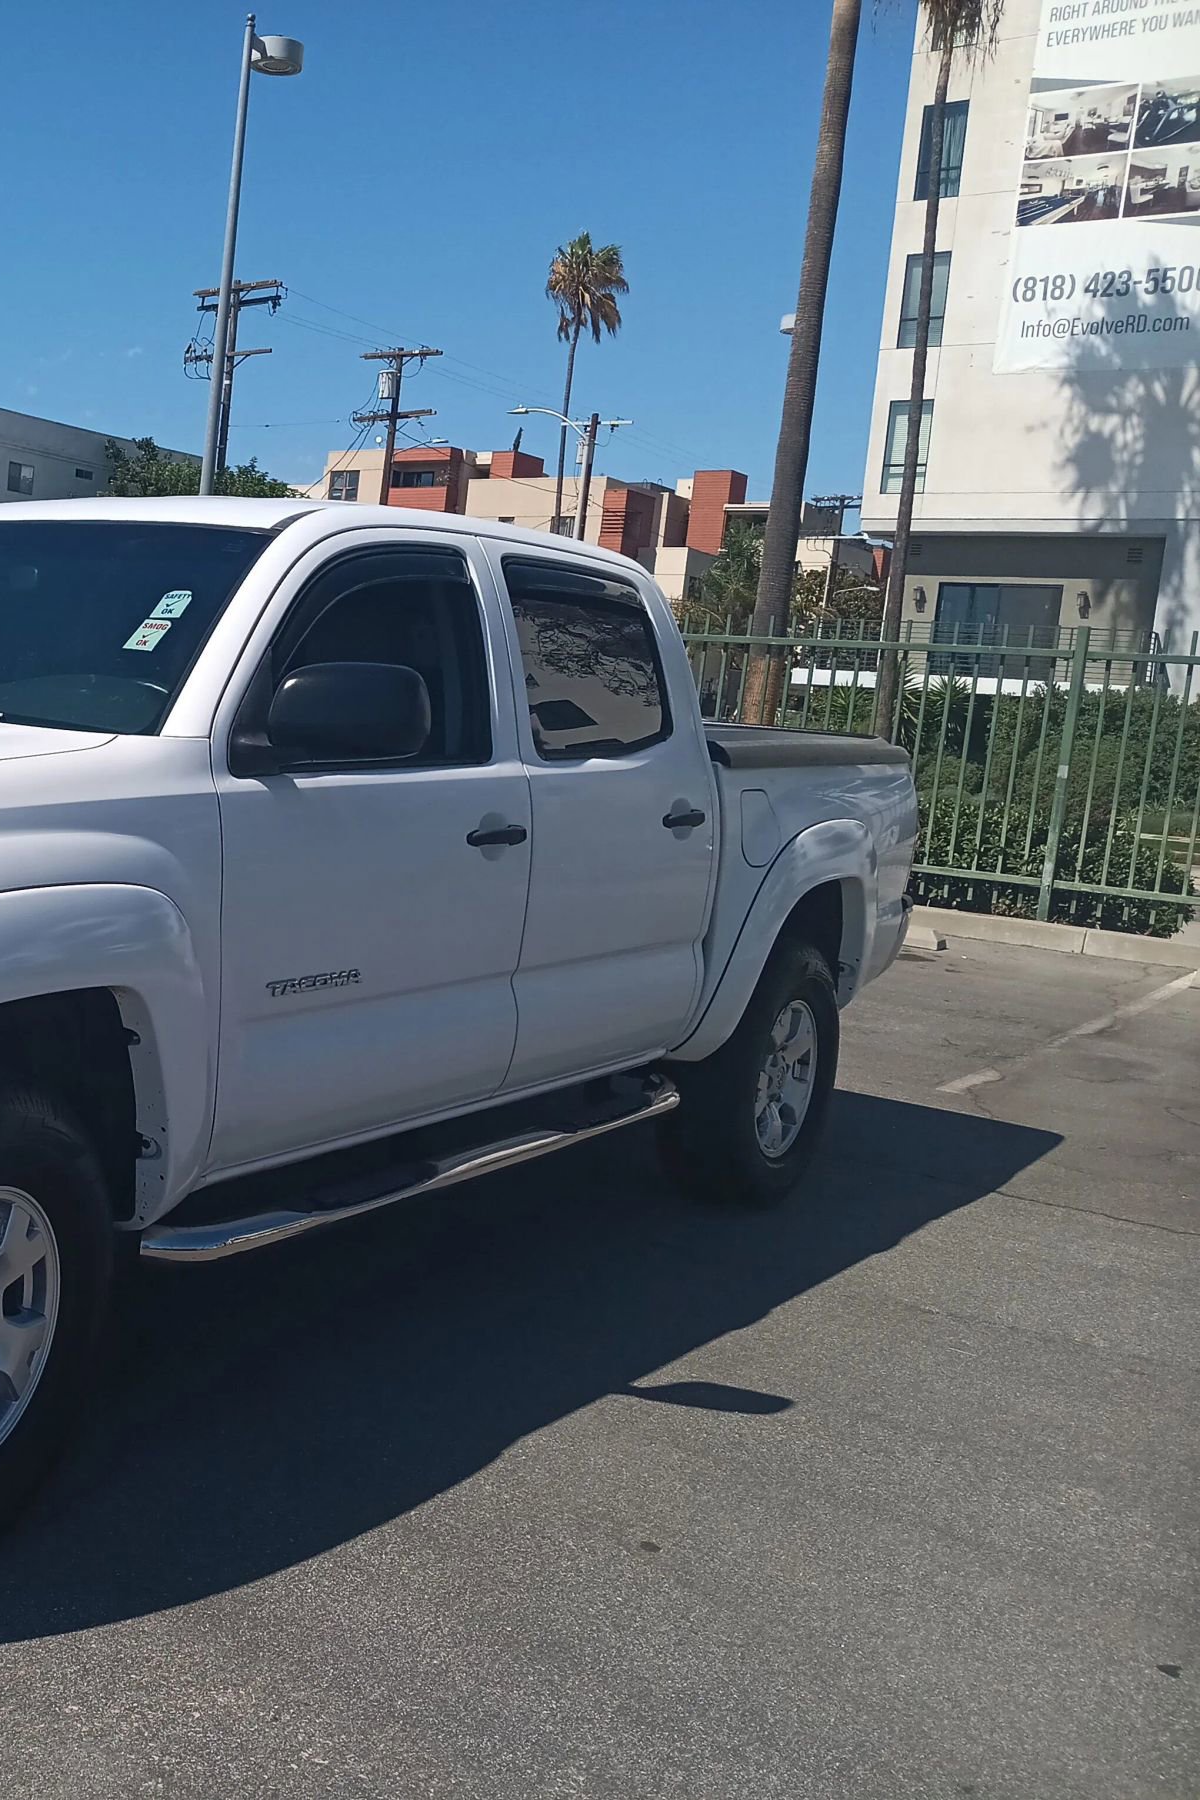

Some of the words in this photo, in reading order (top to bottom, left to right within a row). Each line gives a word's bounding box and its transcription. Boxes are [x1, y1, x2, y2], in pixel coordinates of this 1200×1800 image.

[1049, 2, 1089, 23] RIGHT
[1046, 19, 1137, 47] EVERYWHERE
[1142, 14, 1169, 33] YOU
[1012, 273, 1076, 303] (818)
[1084, 265, 1200, 299] 423-550
[1021, 314, 1190, 339] Info@EvolveRD.com
[142, 622, 169, 631] SMOG
[135, 639, 150, 647] OK
[265, 968, 362, 998] TACOMA
